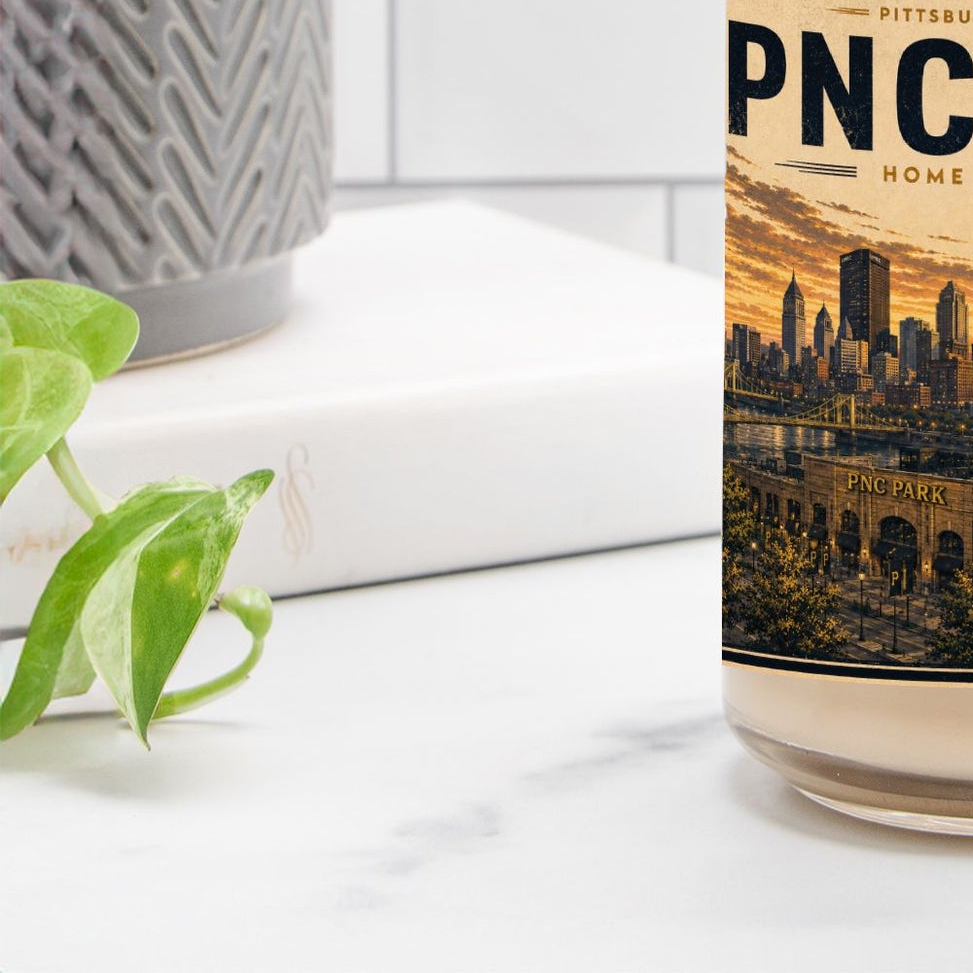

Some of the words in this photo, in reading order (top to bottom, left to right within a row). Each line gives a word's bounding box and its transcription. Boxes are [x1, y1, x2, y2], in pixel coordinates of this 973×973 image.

[882, 165, 964, 185] HOME
[847, 471, 886, 494] PNC
[892, 479, 947, 505] PARK
